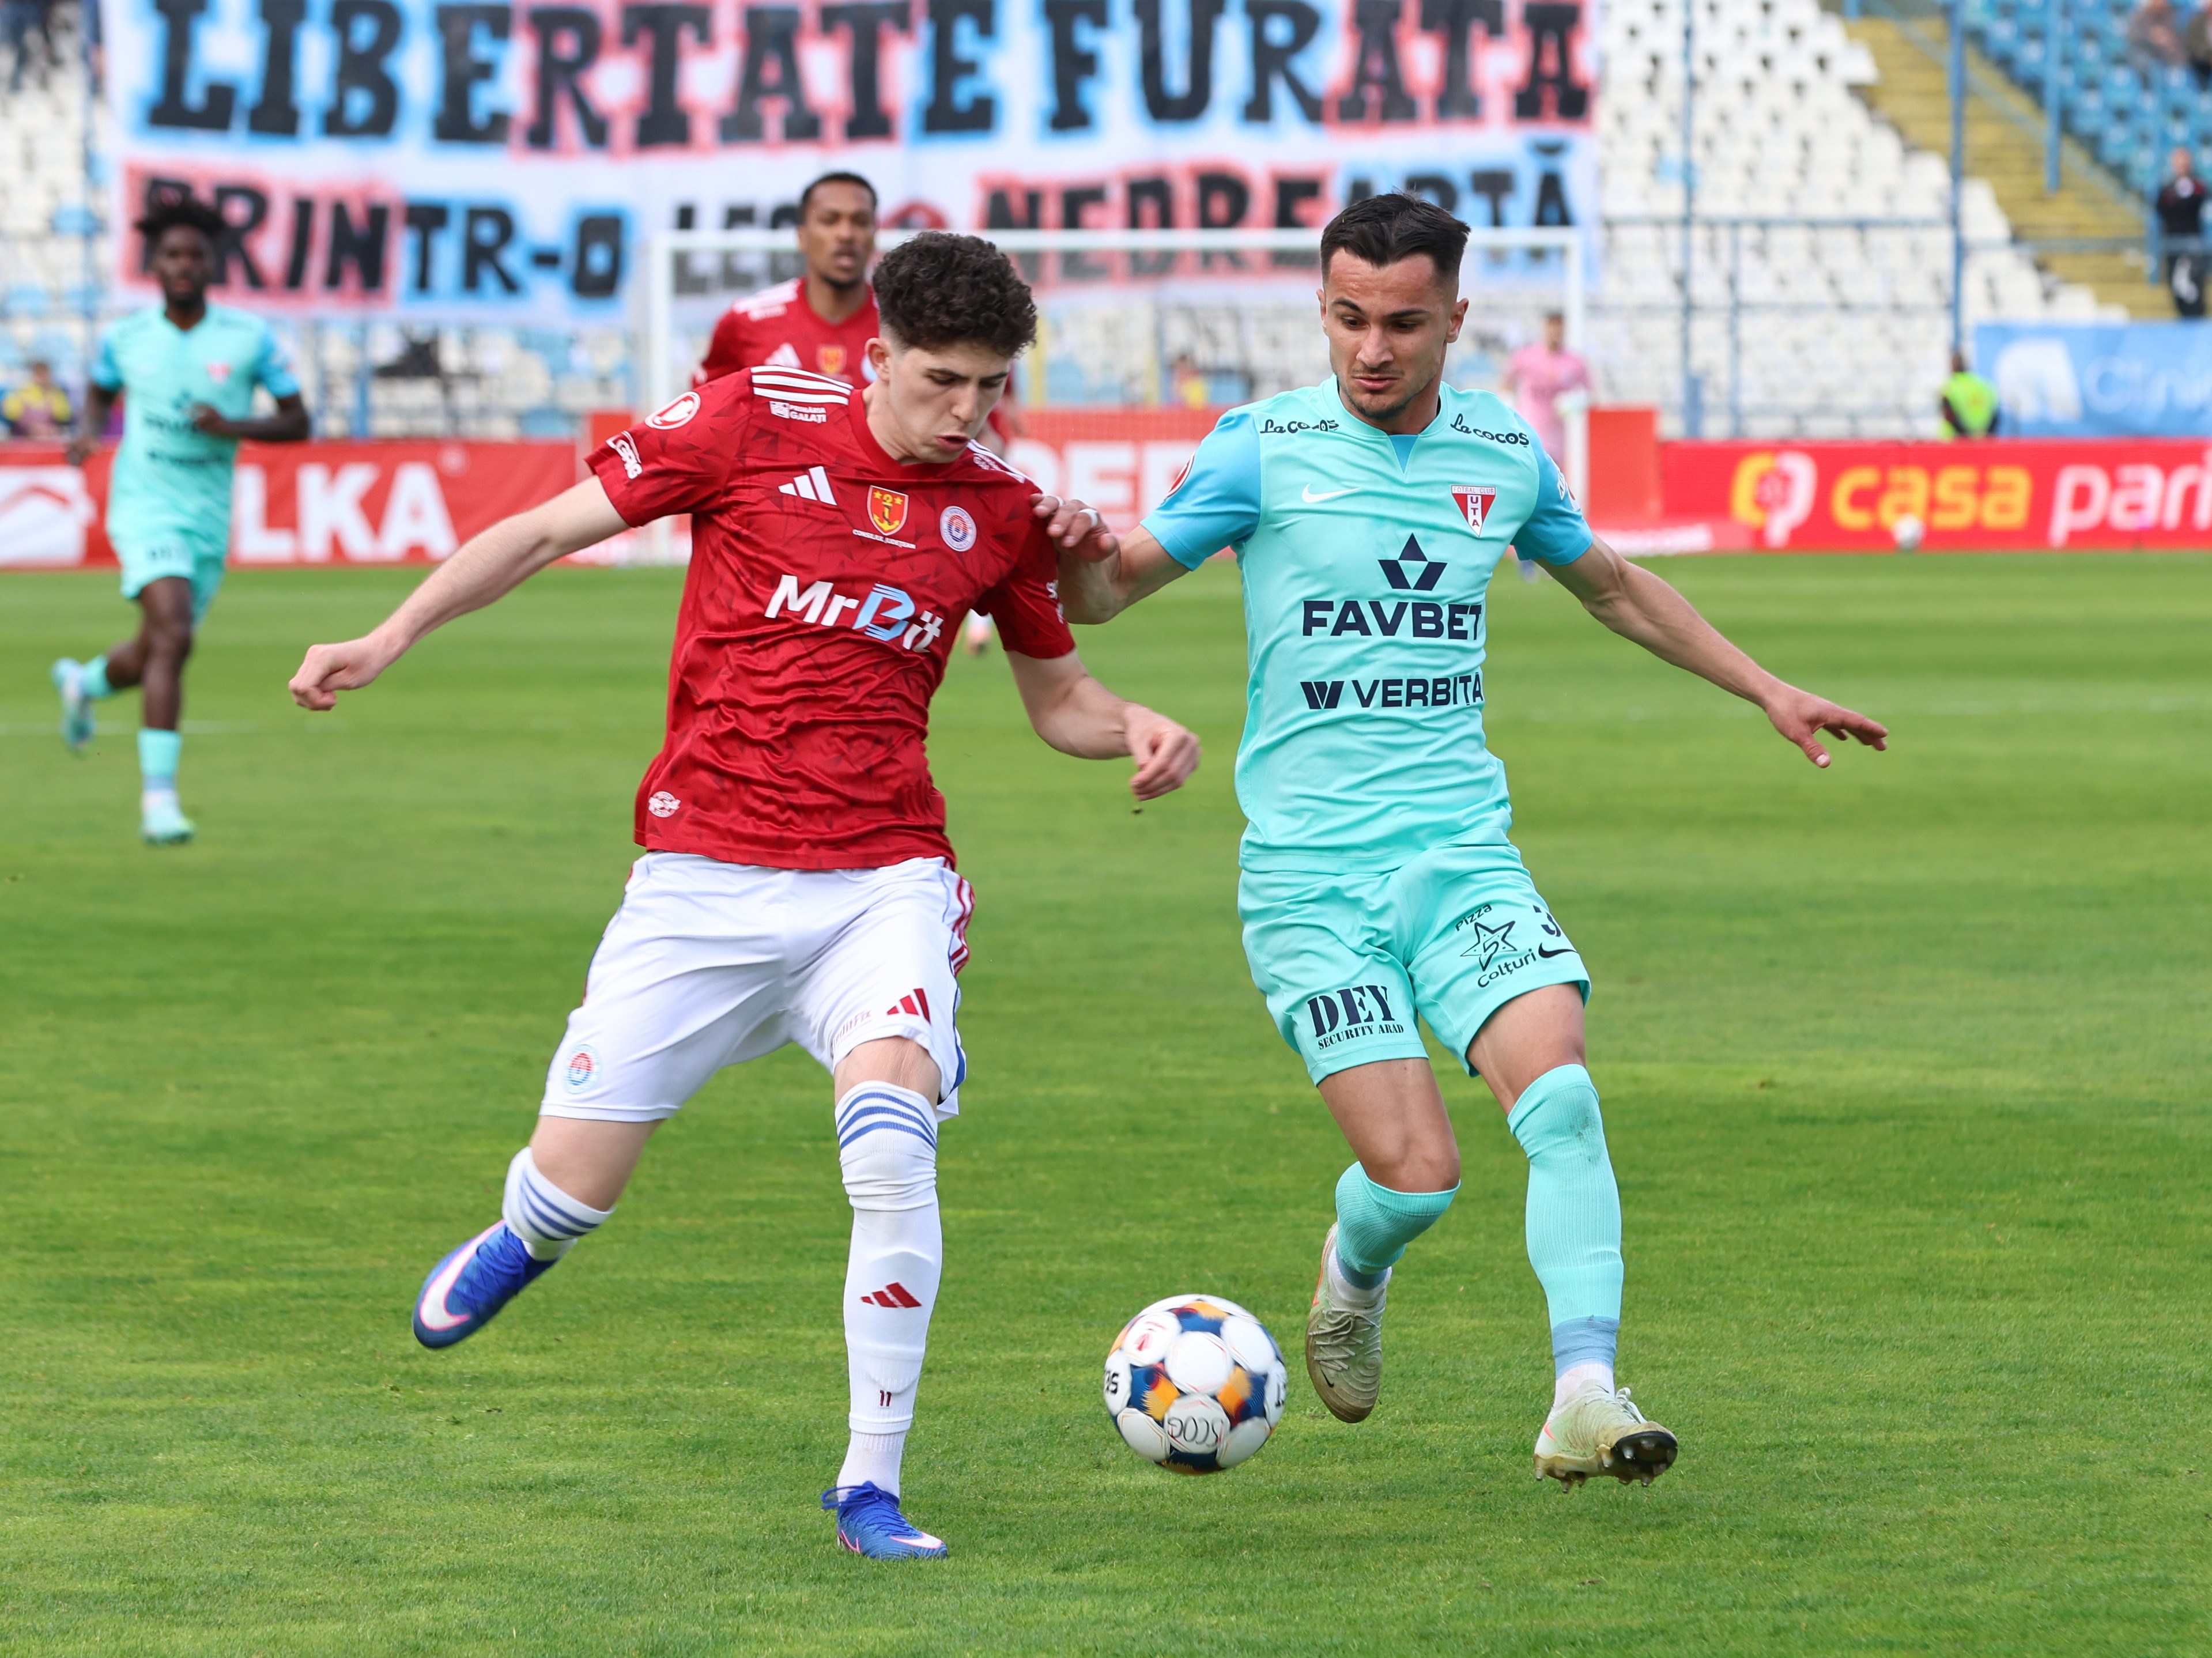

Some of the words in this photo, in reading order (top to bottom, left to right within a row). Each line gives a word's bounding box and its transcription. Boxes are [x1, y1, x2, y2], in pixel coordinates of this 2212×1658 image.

[145, 0, 995, 149] LIBERTATE
[232, 462, 461, 564] LKA
[1470, 496, 1480, 527] UTA
[1830, 465, 2033, 531] casa
[764, 574, 944, 654] MrBit
[1303, 600, 1482, 640] FAVBET
[1455, 903, 1493, 932] Pizza
[1307, 985, 1396, 1038] DEY
[1318, 1025, 1374, 1051] SECURITY
[1378, 1023, 1405, 1034] ARAD
[879, 1389, 892, 1407] 11
